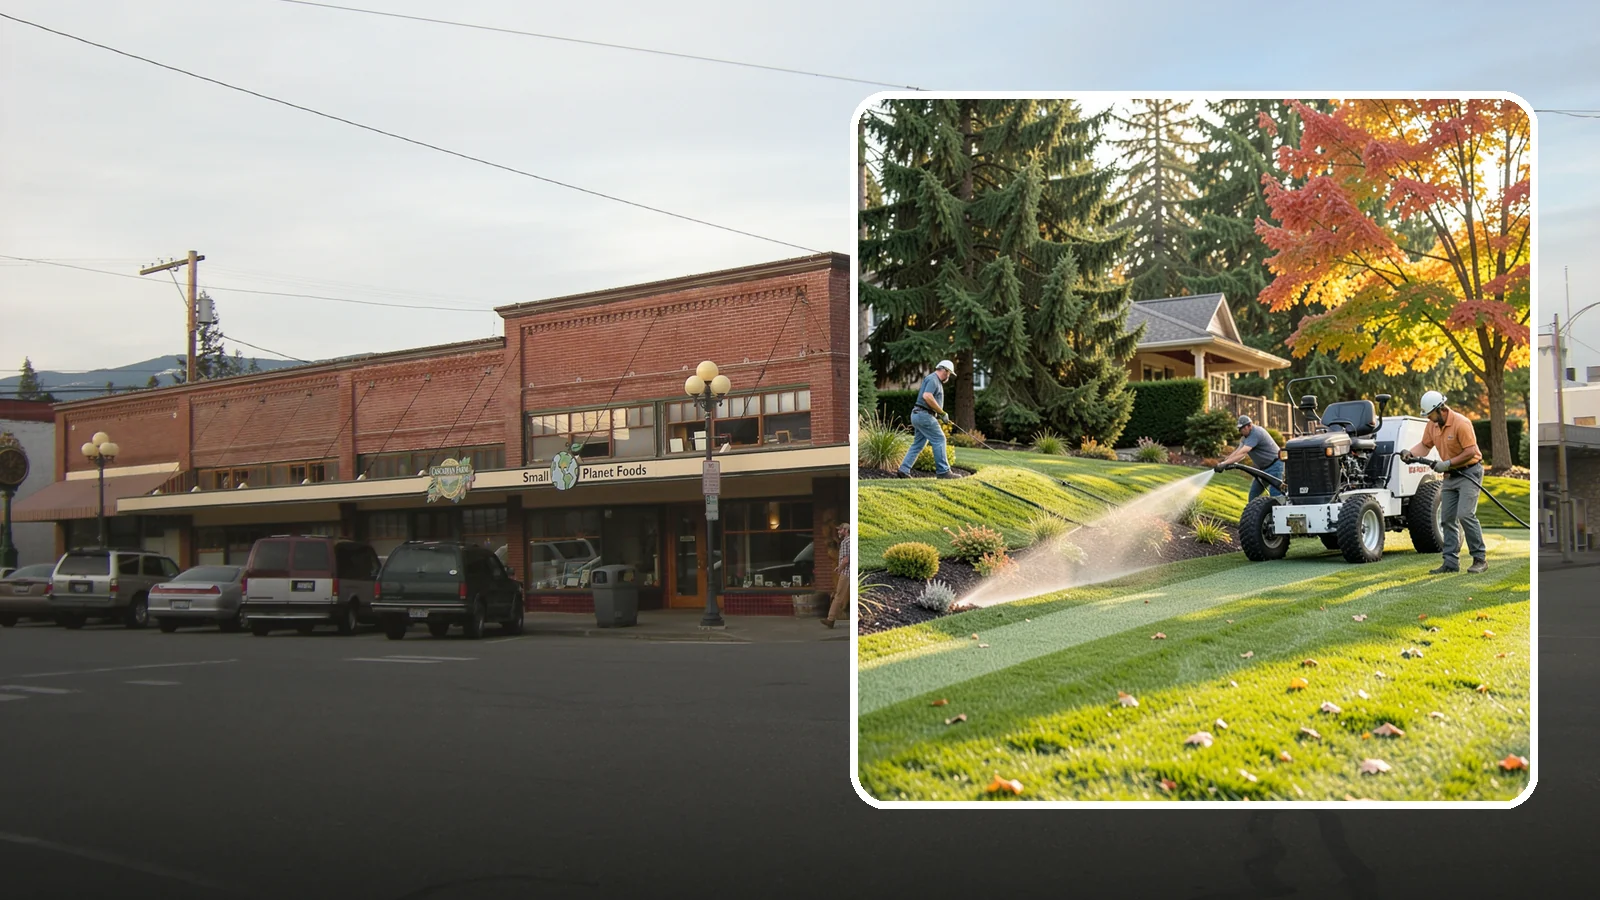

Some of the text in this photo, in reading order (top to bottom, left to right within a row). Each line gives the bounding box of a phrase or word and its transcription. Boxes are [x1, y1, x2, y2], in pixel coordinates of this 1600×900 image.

[523, 464, 647, 483] Small Planet Foods
